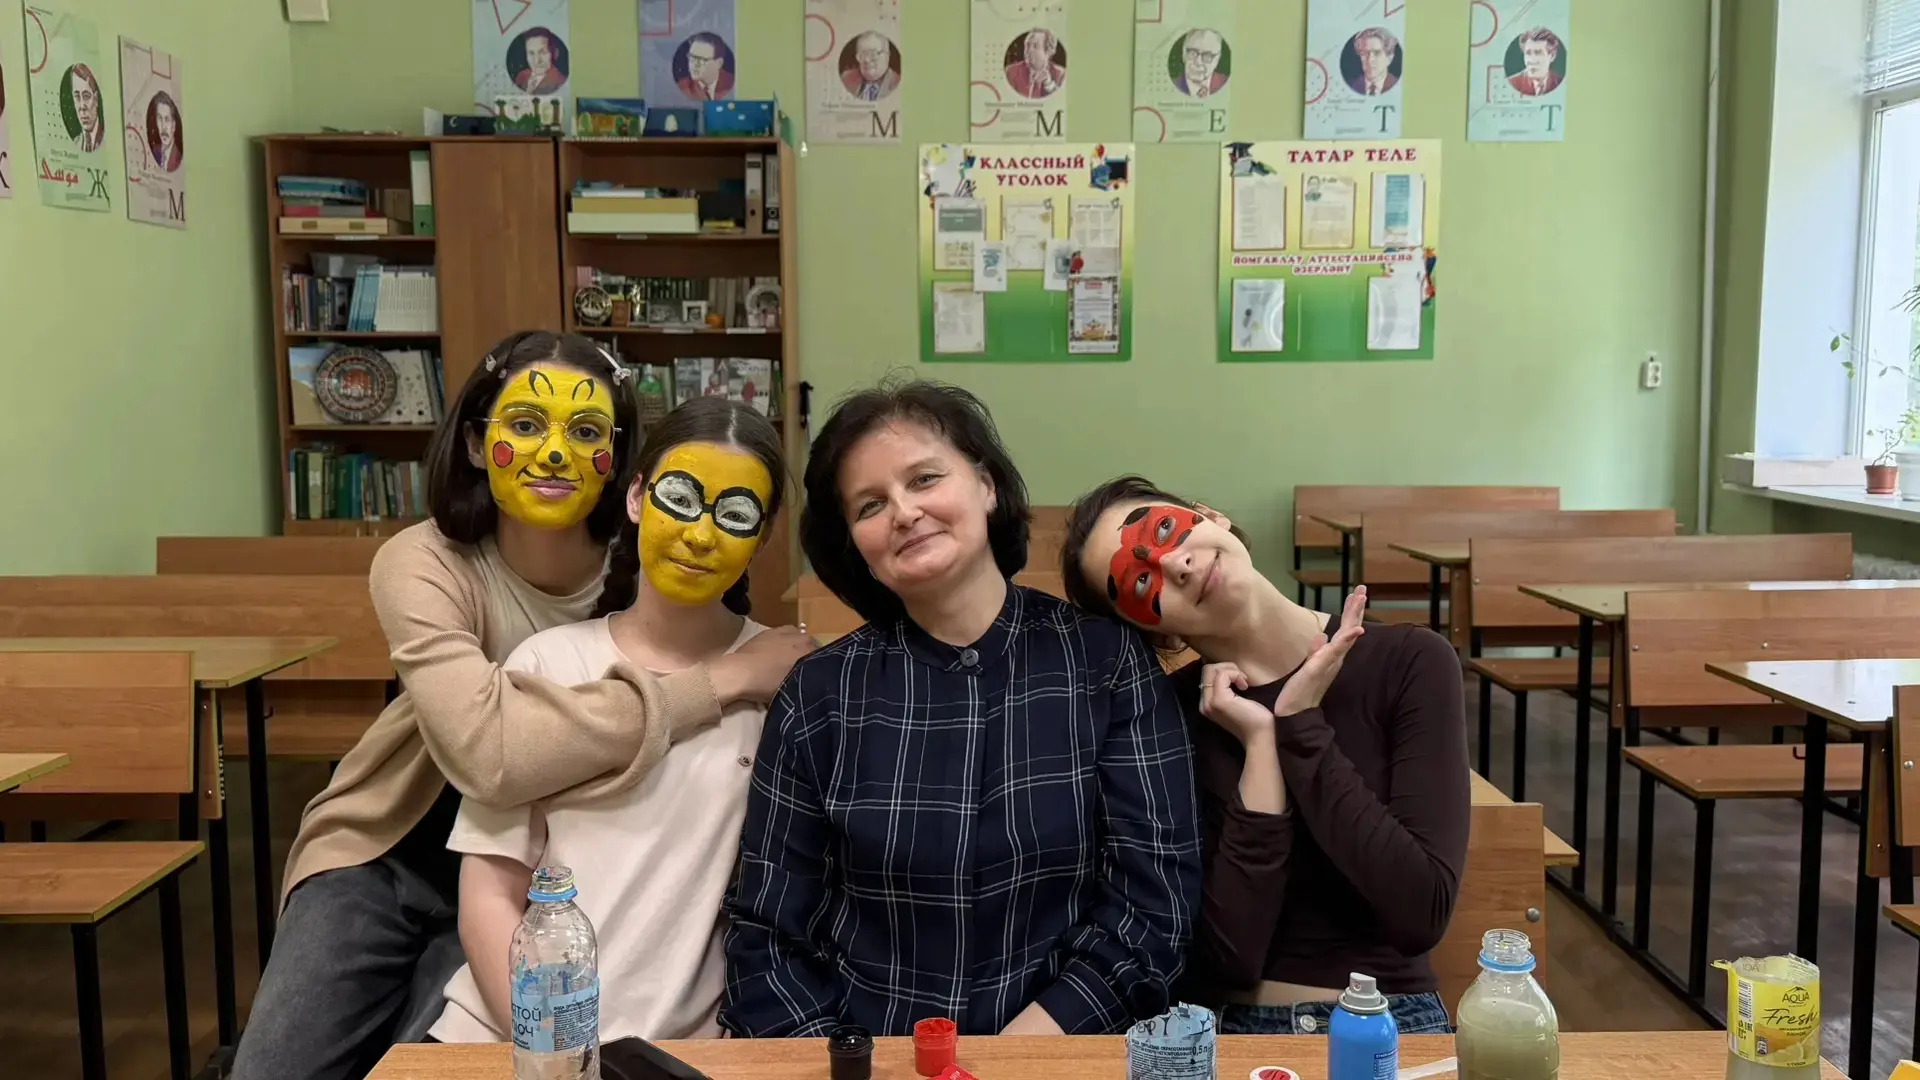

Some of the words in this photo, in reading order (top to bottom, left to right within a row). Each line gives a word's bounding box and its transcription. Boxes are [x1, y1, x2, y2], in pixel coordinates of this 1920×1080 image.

[870, 110, 899, 138] М
[1034, 110, 1063, 138] М
[1373, 105, 1396, 133] Т
[1539, 104, 1562, 132] Т
[979, 154, 1085, 170] КЛАССНЫЙ
[1288, 149, 1354, 163] ТАТАР
[1365, 148, 1417, 162] ТЕЛЕ
[996, 174, 1068, 187] УГОЛОК
[168, 188, 186, 222] М
[1781, 992, 1810, 1004] AQUA
[1761, 1005, 1818, 1025] Fresh
[1192, 1045, 1203, 1056] 0,5
